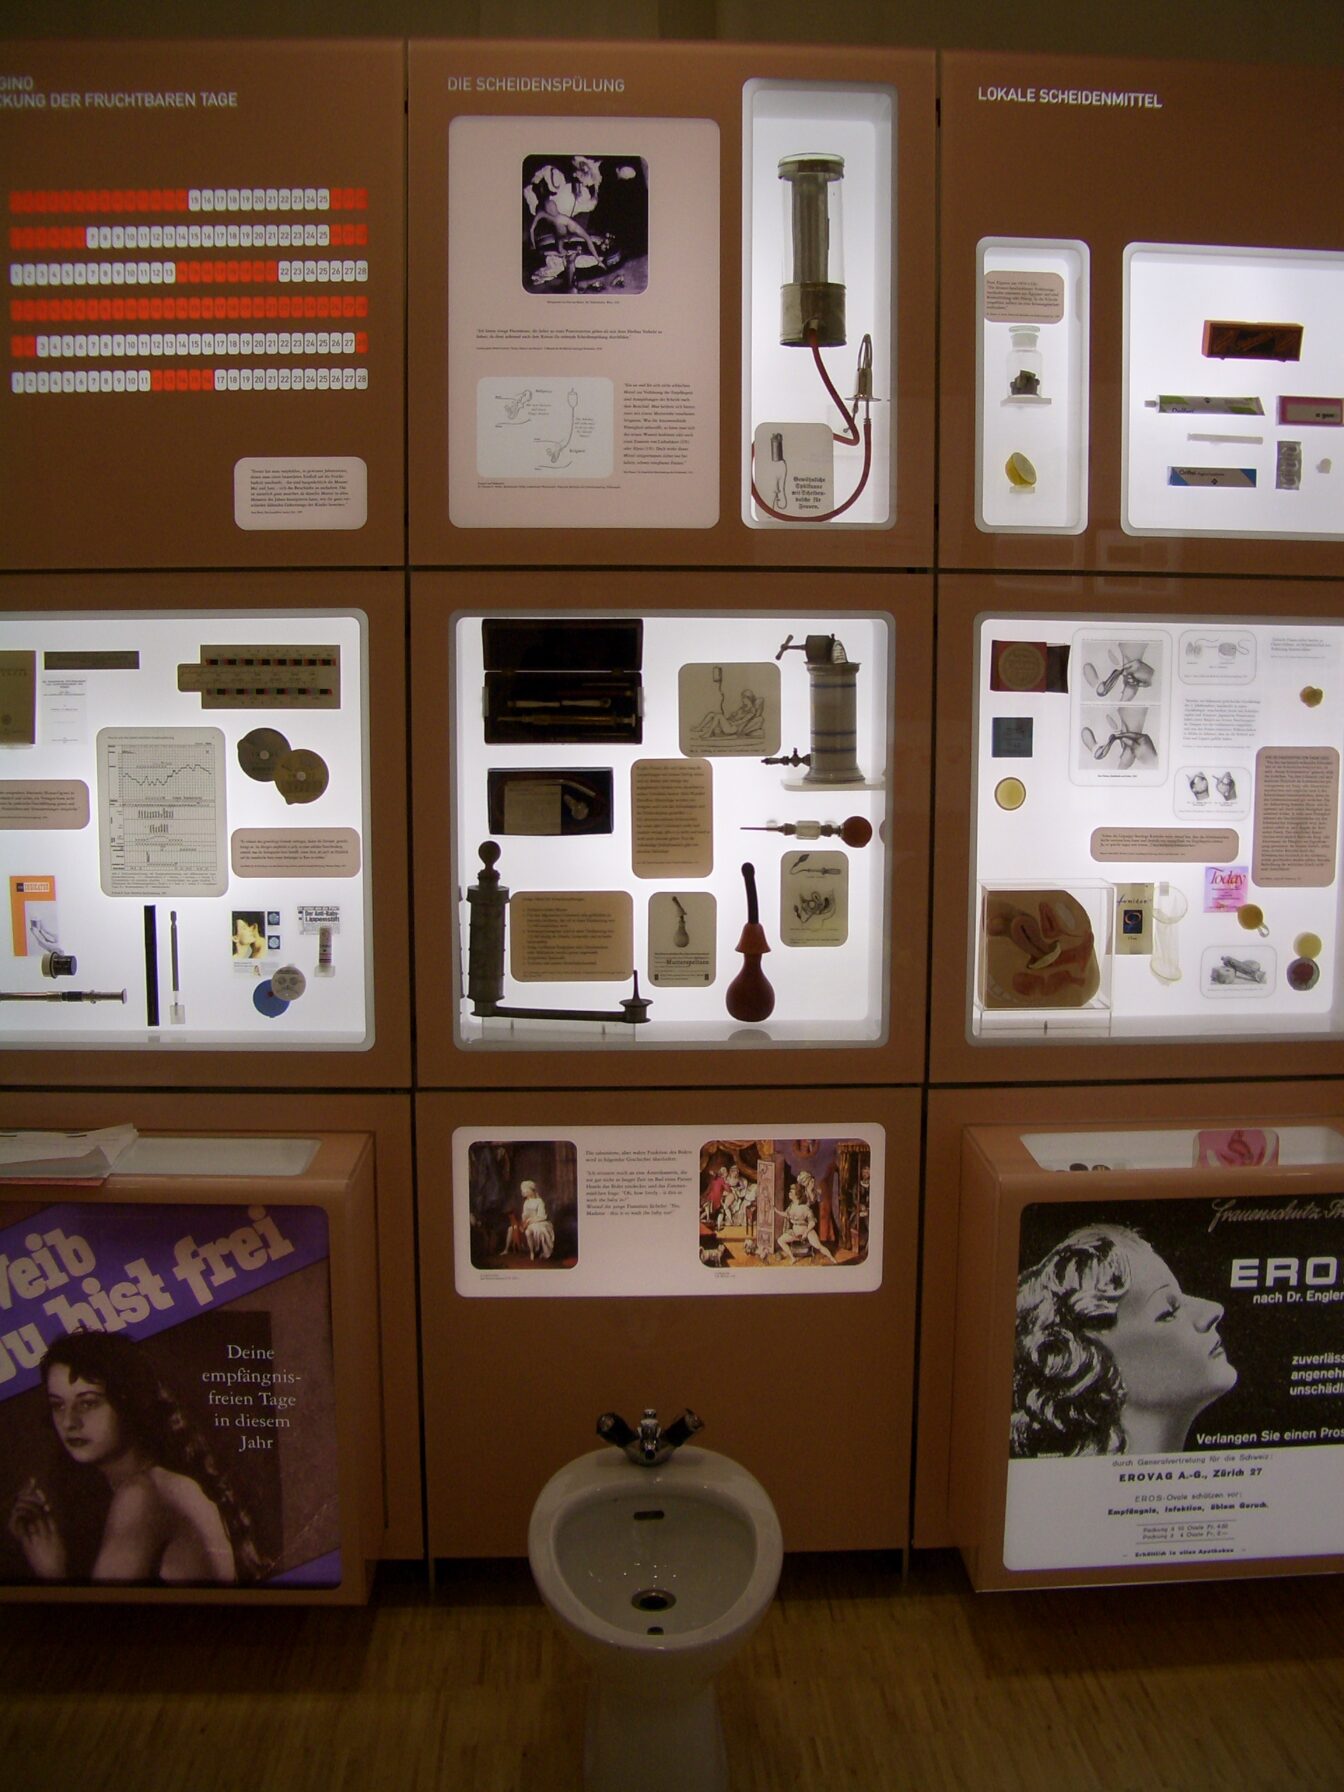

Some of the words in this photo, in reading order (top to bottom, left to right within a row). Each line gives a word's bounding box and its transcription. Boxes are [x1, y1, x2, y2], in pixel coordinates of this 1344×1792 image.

[448, 77, 472, 91] DIE
[476, 76, 625, 92] SCHEIDENSPÜLUNG
[0, 93, 46, 108] KUNG
[50, 93, 80, 108] DER
[84, 92, 196, 108] FRUCHTBAREN
[200, 92, 238, 107] TAGE
[978, 86, 1036, 102] LOKALE
[1040, 89, 1164, 108] SCHEIDENMITTEL
[1208, 867, 1246, 888] Today
[172, 1204, 295, 1306] frei
[1230, 1256, 1344, 1288] ERO
[1253, 1292, 1282, 1304] nach
[1287, 1291, 1303, 1302] Dr.
[226, 1344, 275, 1359] Deine
[202, 1368, 302, 1387] empfängnis-
[1290, 1367, 1344, 1381] angeneh
[1289, 1382, 1344, 1395] unschädl
[208, 1390, 253, 1405] freien
[258, 1392, 297, 1410] Tage
[214, 1413, 230, 1426] in
[235, 1414, 290, 1427] diesem
[238, 1436, 274, 1452] Jahr
[1196, 1433, 1257, 1444] Verlangen
[1261, 1430, 1281, 1441] Sie
[1284, 1430, 1316, 1441] einen
[1137, 1456, 1206, 1466] Generalvertretung
[1120, 1472, 1173, 1482] EROVAG
[1213, 1468, 1244, 1478] Zürich
[1250, 1467, 1262, 1476] 27
